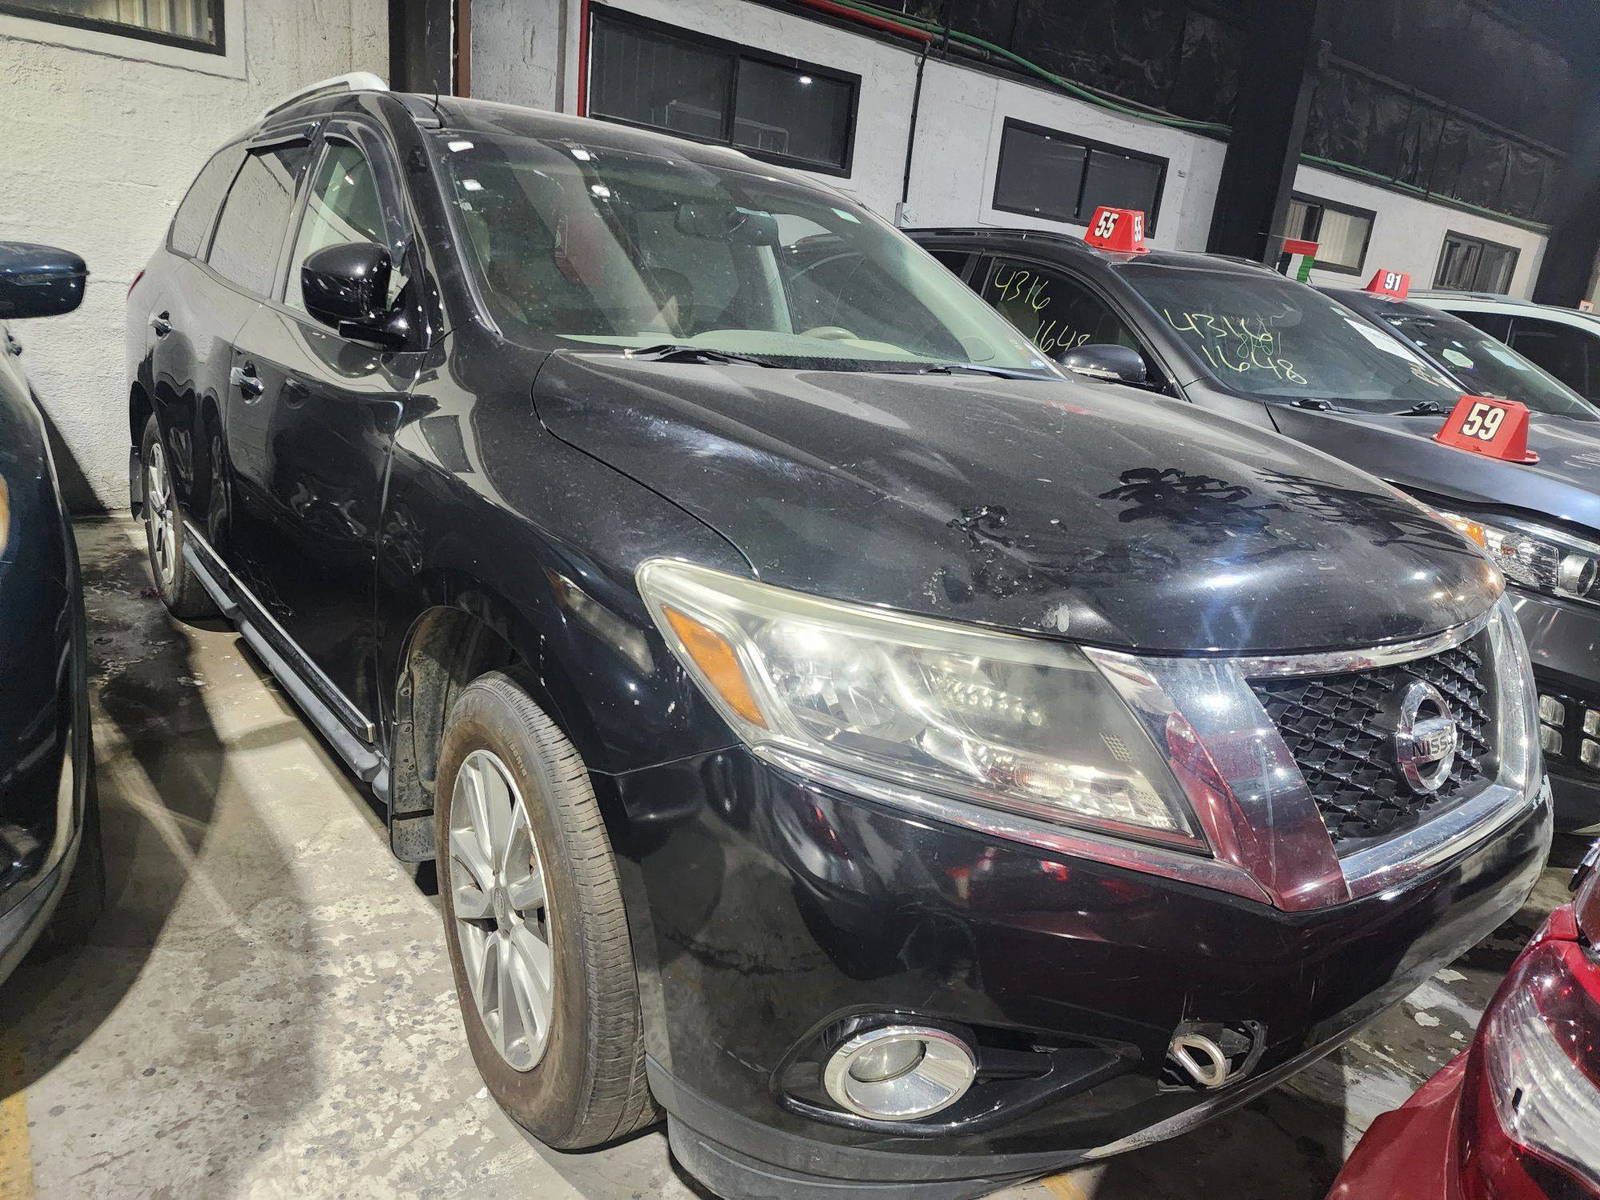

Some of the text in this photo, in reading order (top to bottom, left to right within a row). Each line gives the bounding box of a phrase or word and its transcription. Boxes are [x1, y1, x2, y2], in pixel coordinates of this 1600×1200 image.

[1094, 210, 1120, 239] 55
[994, 263, 1051, 312] 4316
[1384, 272, 1402, 292] 91
[1163, 308, 1273, 342] 4316
[1200, 344, 1308, 385] 11648
[1462, 402, 1506, 441] 59
[1411, 734, 1455, 757] NISS
